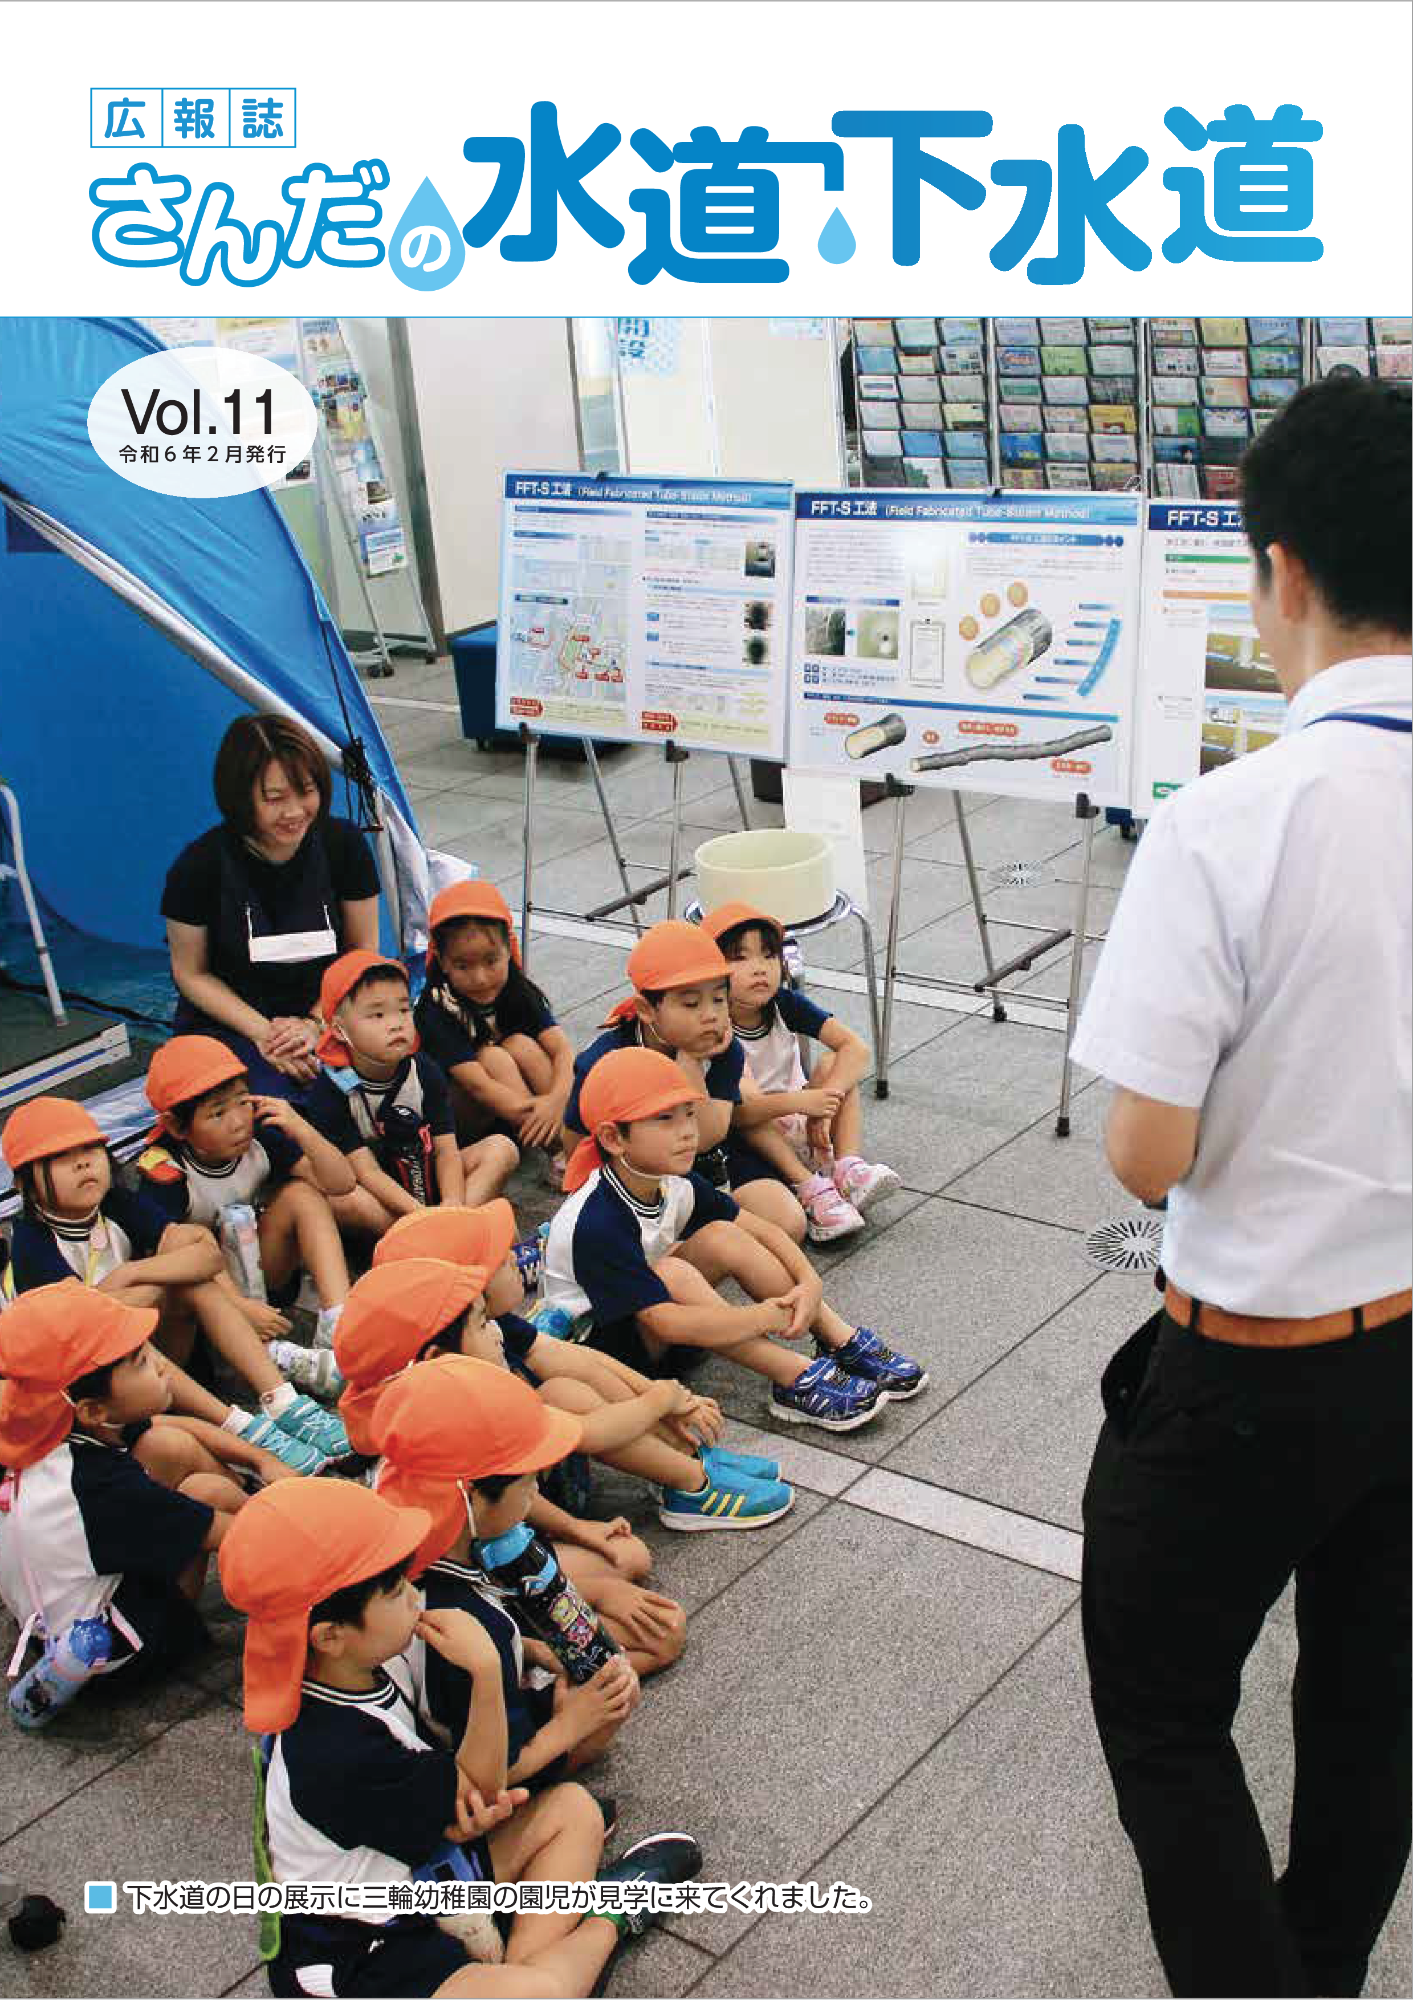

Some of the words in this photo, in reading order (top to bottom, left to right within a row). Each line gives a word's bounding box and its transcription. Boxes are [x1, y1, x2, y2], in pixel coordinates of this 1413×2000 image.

[516, 481, 549, 495] FFT-S
[811, 500, 851, 516] FFT-S
[1167, 510, 1219, 527] FFT-S
